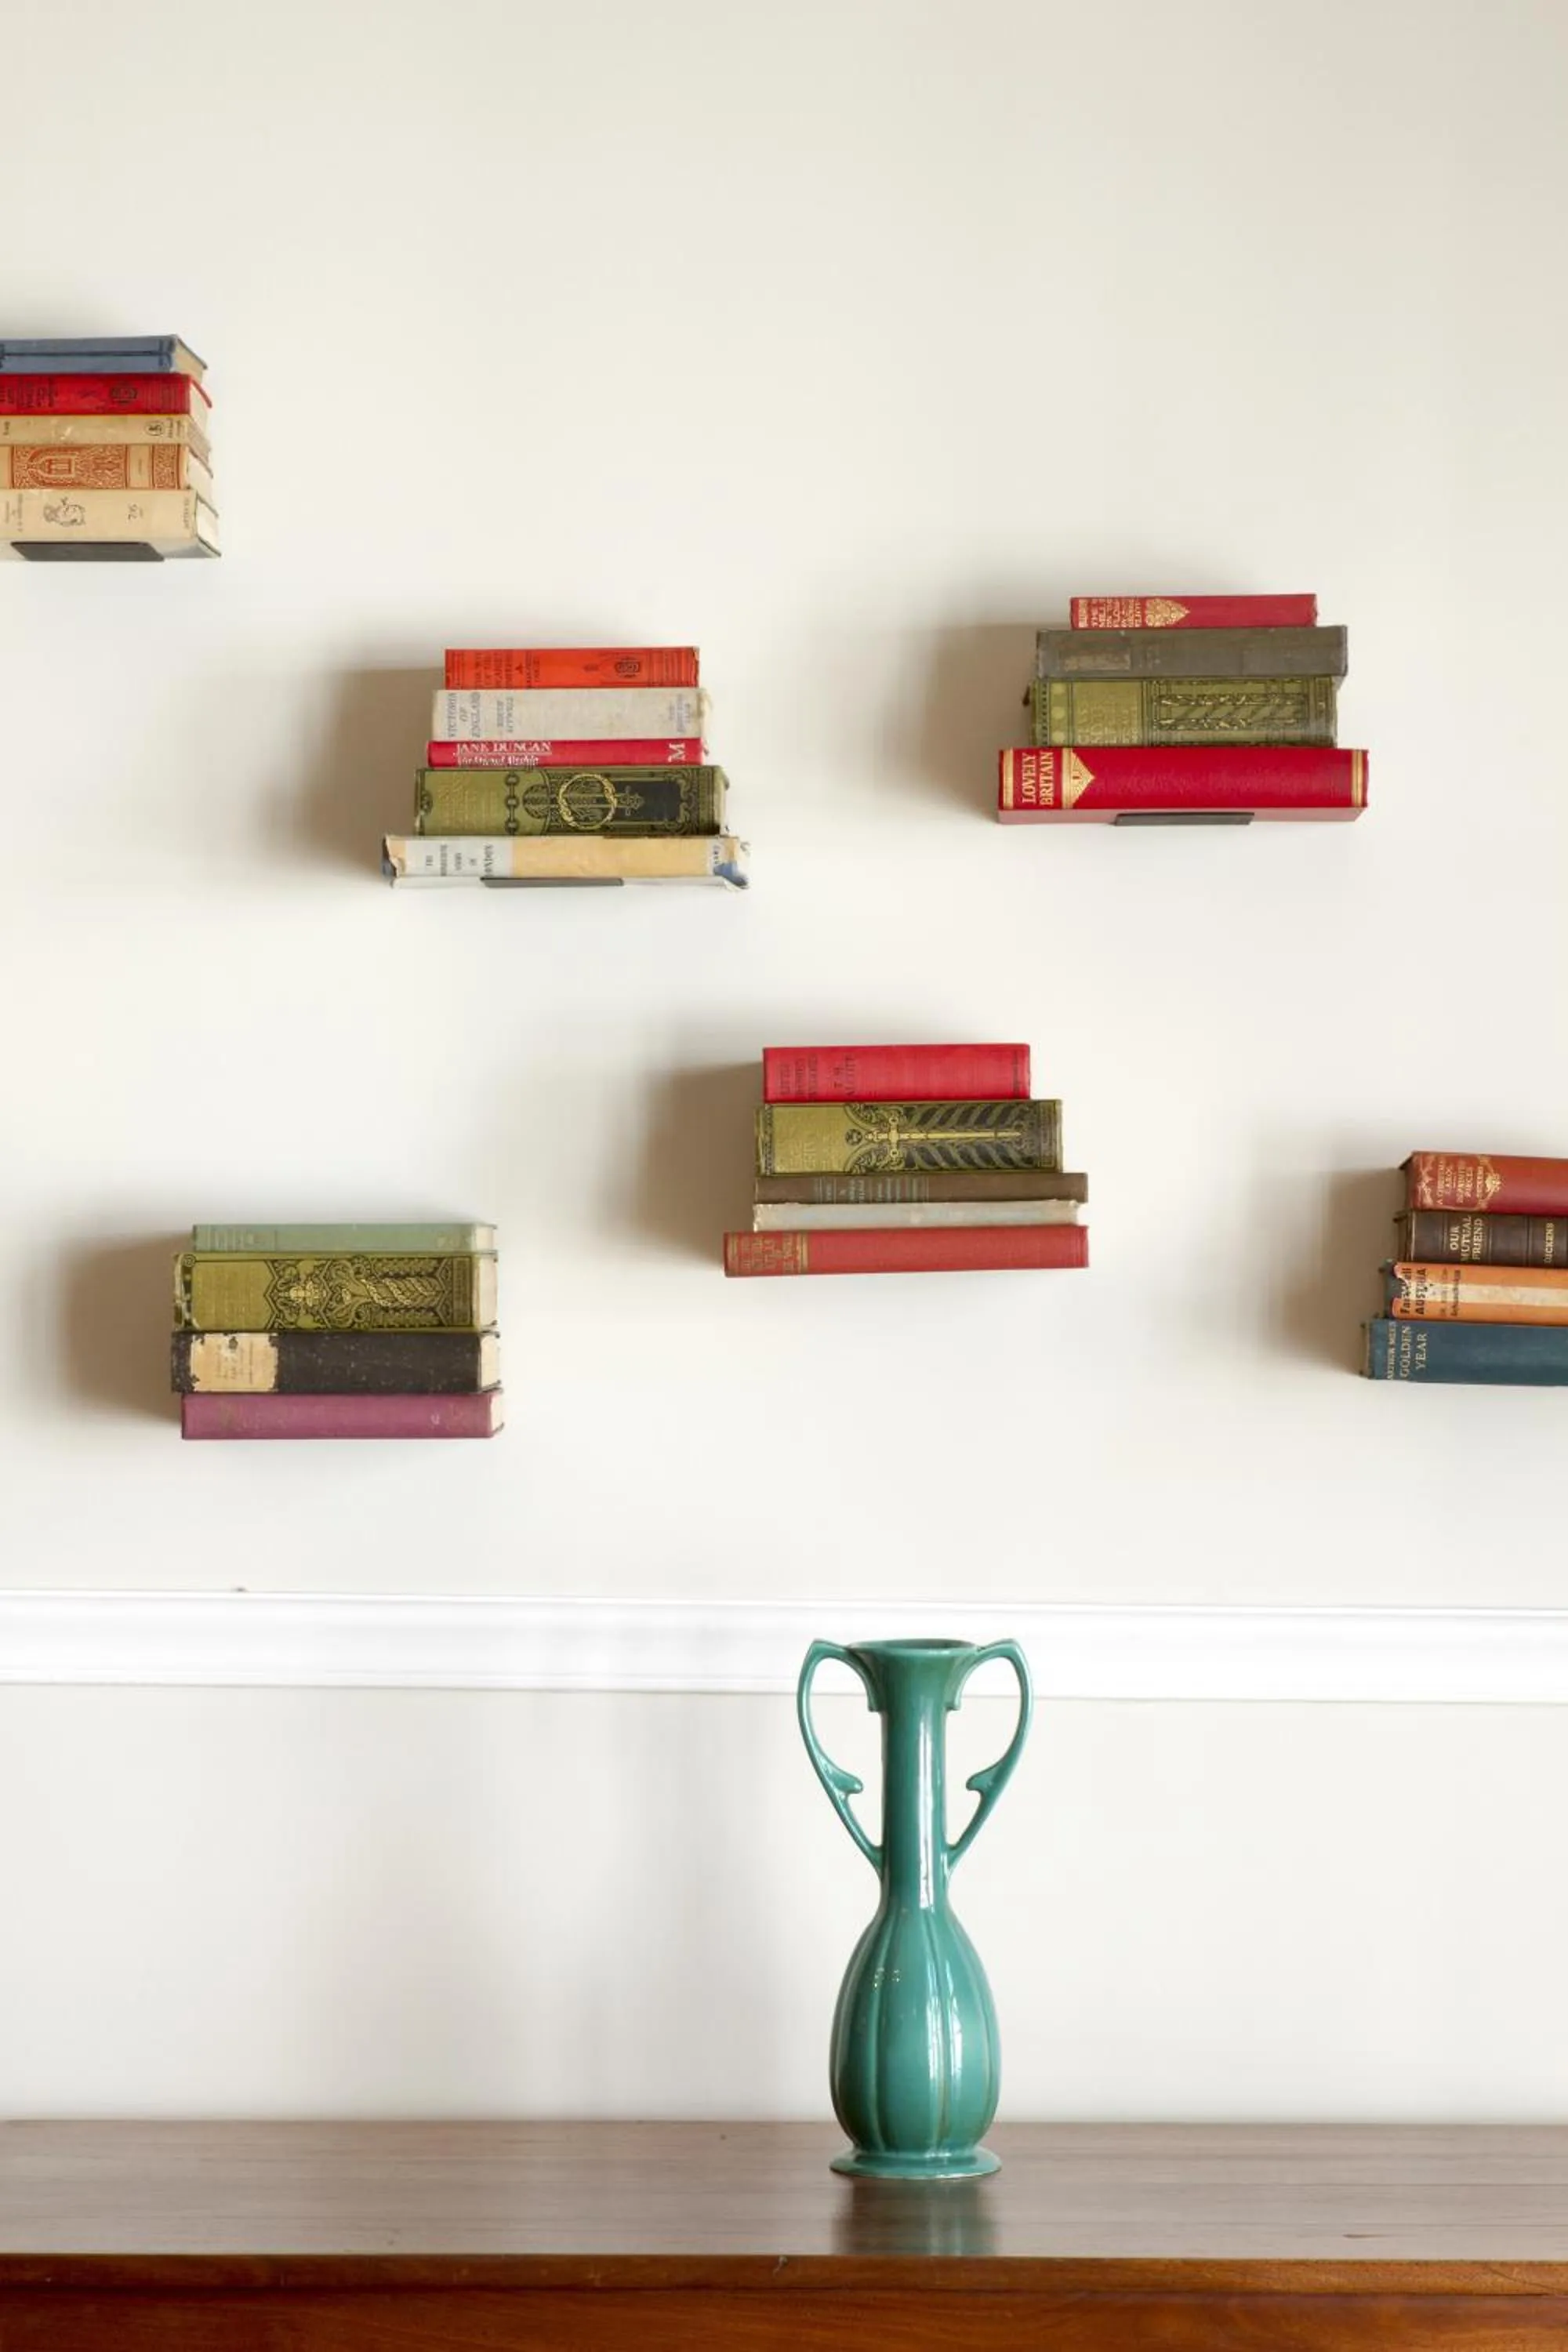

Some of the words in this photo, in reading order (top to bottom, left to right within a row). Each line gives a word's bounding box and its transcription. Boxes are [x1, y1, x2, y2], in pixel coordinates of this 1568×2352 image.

[1022, 752, 1036, 804] LOVELY
[1039, 750, 1054, 806] BRITAIN
[1450, 1225, 1460, 1251] OUR
[1460, 1215, 1472, 1261] MUTUAL
[1472, 1218, 1483, 1260] FRIEND
[1399, 1325, 1412, 1377] GOLDEN
[1415, 1332, 1428, 1370] YEAR
